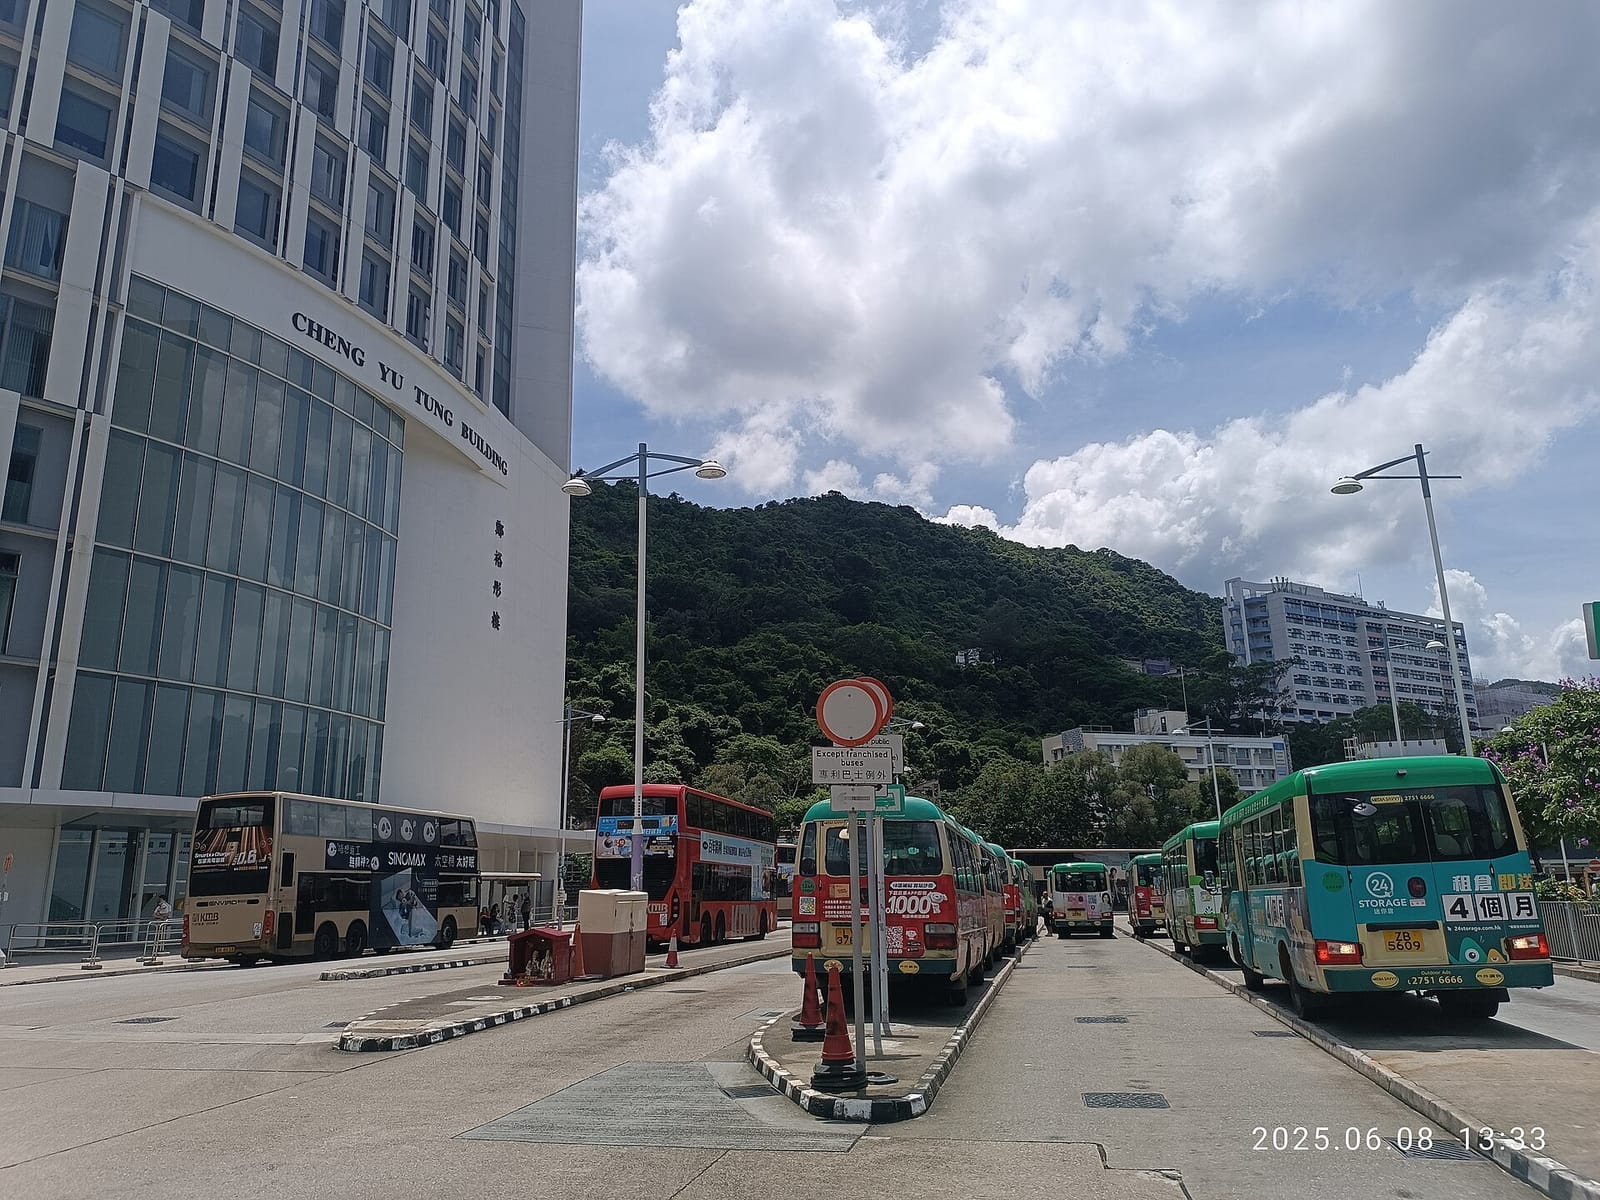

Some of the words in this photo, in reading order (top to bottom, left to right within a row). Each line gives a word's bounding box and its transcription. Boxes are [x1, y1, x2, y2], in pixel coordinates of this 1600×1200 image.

[291, 312, 365, 367] CHENG
[378, 361, 405, 391] YU
[413, 385, 454, 427] TUNG
[460, 421, 508, 476] BUILDING
[816, 750, 844, 759] Except
[846, 750, 888, 758] franchised
[840, 759, 864, 767] buses
[819, 769, 887, 780] 專利巴士例外
[388, 851, 426, 867] SINOMAX
[1371, 879, 1389, 892] 24
[1452, 873, 1534, 892] 租倉即送
[888, 895, 932, 914] 1000
[1358, 898, 1408, 908] STORAGE
[1449, 896, 1534, 918] 4個月
[1394, 931, 1411, 941] ZB
[1388, 941, 1421, 951] 5609
[1412, 976, 1435, 985] 2751
[1438, 975, 1463, 984] 6666
